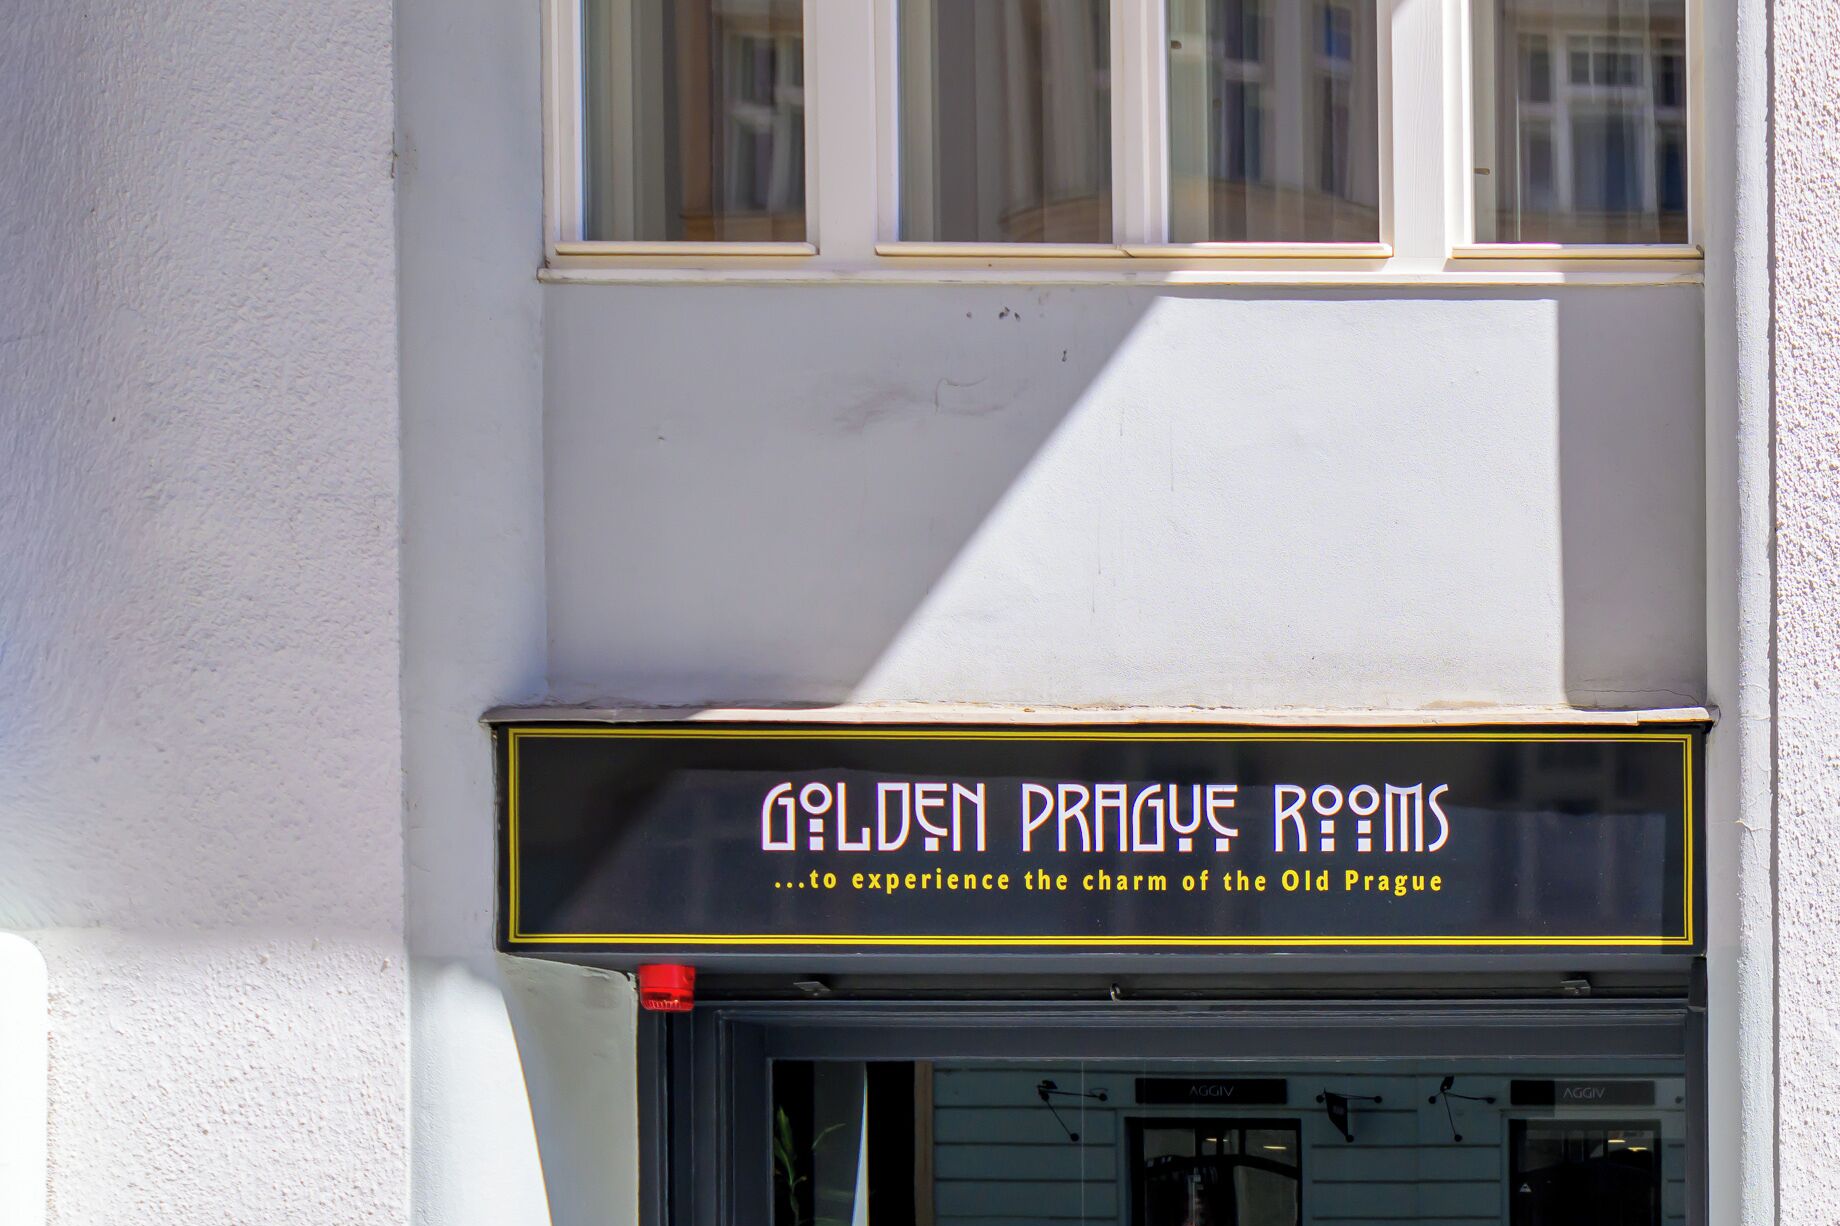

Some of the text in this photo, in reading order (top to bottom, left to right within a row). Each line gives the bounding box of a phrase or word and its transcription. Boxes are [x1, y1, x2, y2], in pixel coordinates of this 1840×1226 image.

[761, 781, 1450, 852] GOLDEN PRAGUE ROOMS
[851, 868, 1009, 895] experience
[1024, 869, 1068, 891] the
[1082, 870, 1167, 891] charm
[1182, 870, 1209, 892] of
[1222, 870, 1267, 891] the
[1281, 869, 1329, 892] Old
[1345, 869, 1443, 897] Prague
